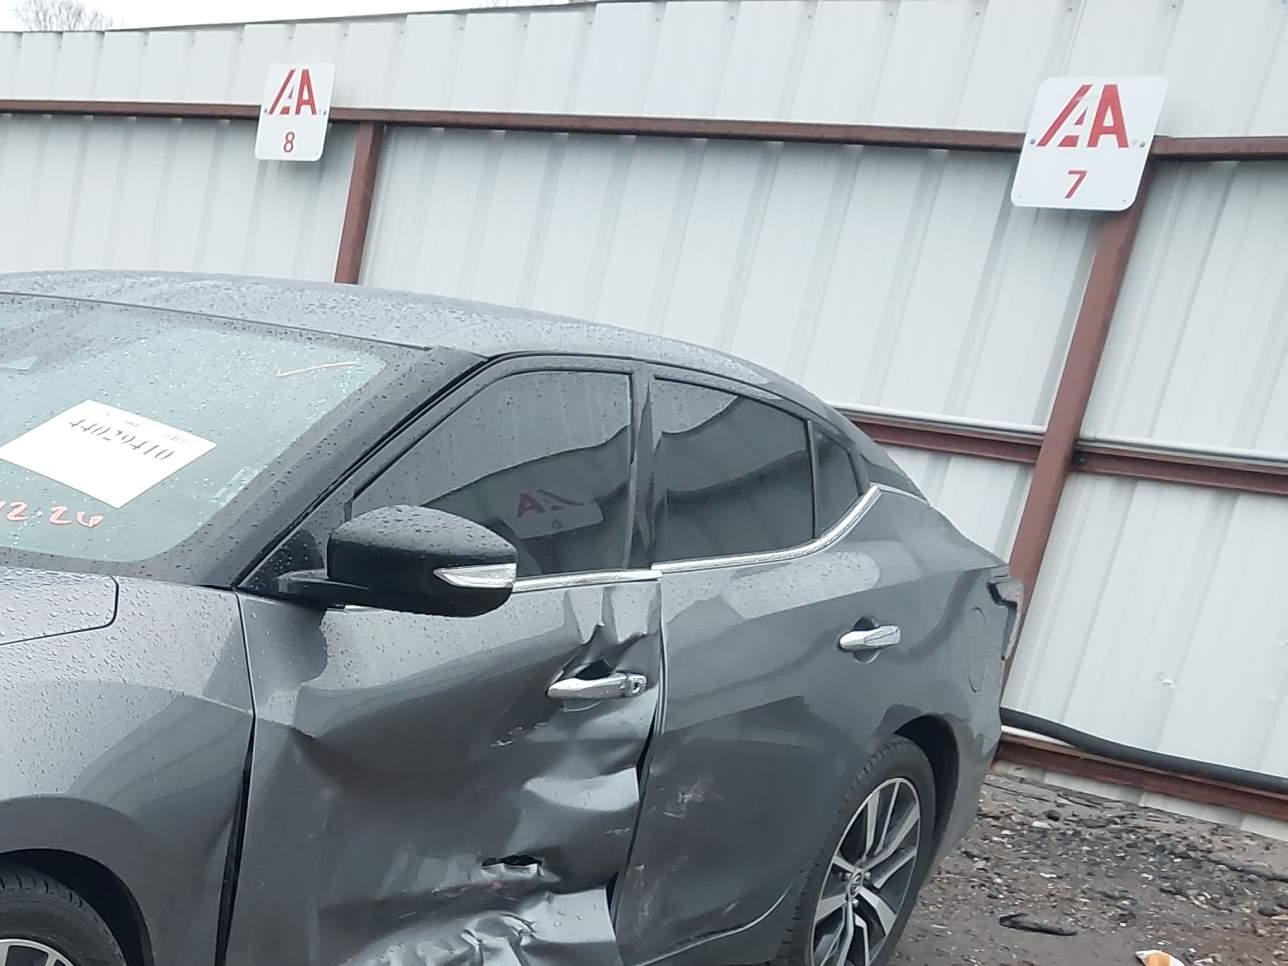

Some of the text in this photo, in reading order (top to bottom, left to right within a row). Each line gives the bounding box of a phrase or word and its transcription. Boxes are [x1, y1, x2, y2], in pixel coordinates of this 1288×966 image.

[283, 131, 296, 154] 8
[1064, 169, 1088, 200] 7
[68, 417, 176, 462] 44029410
